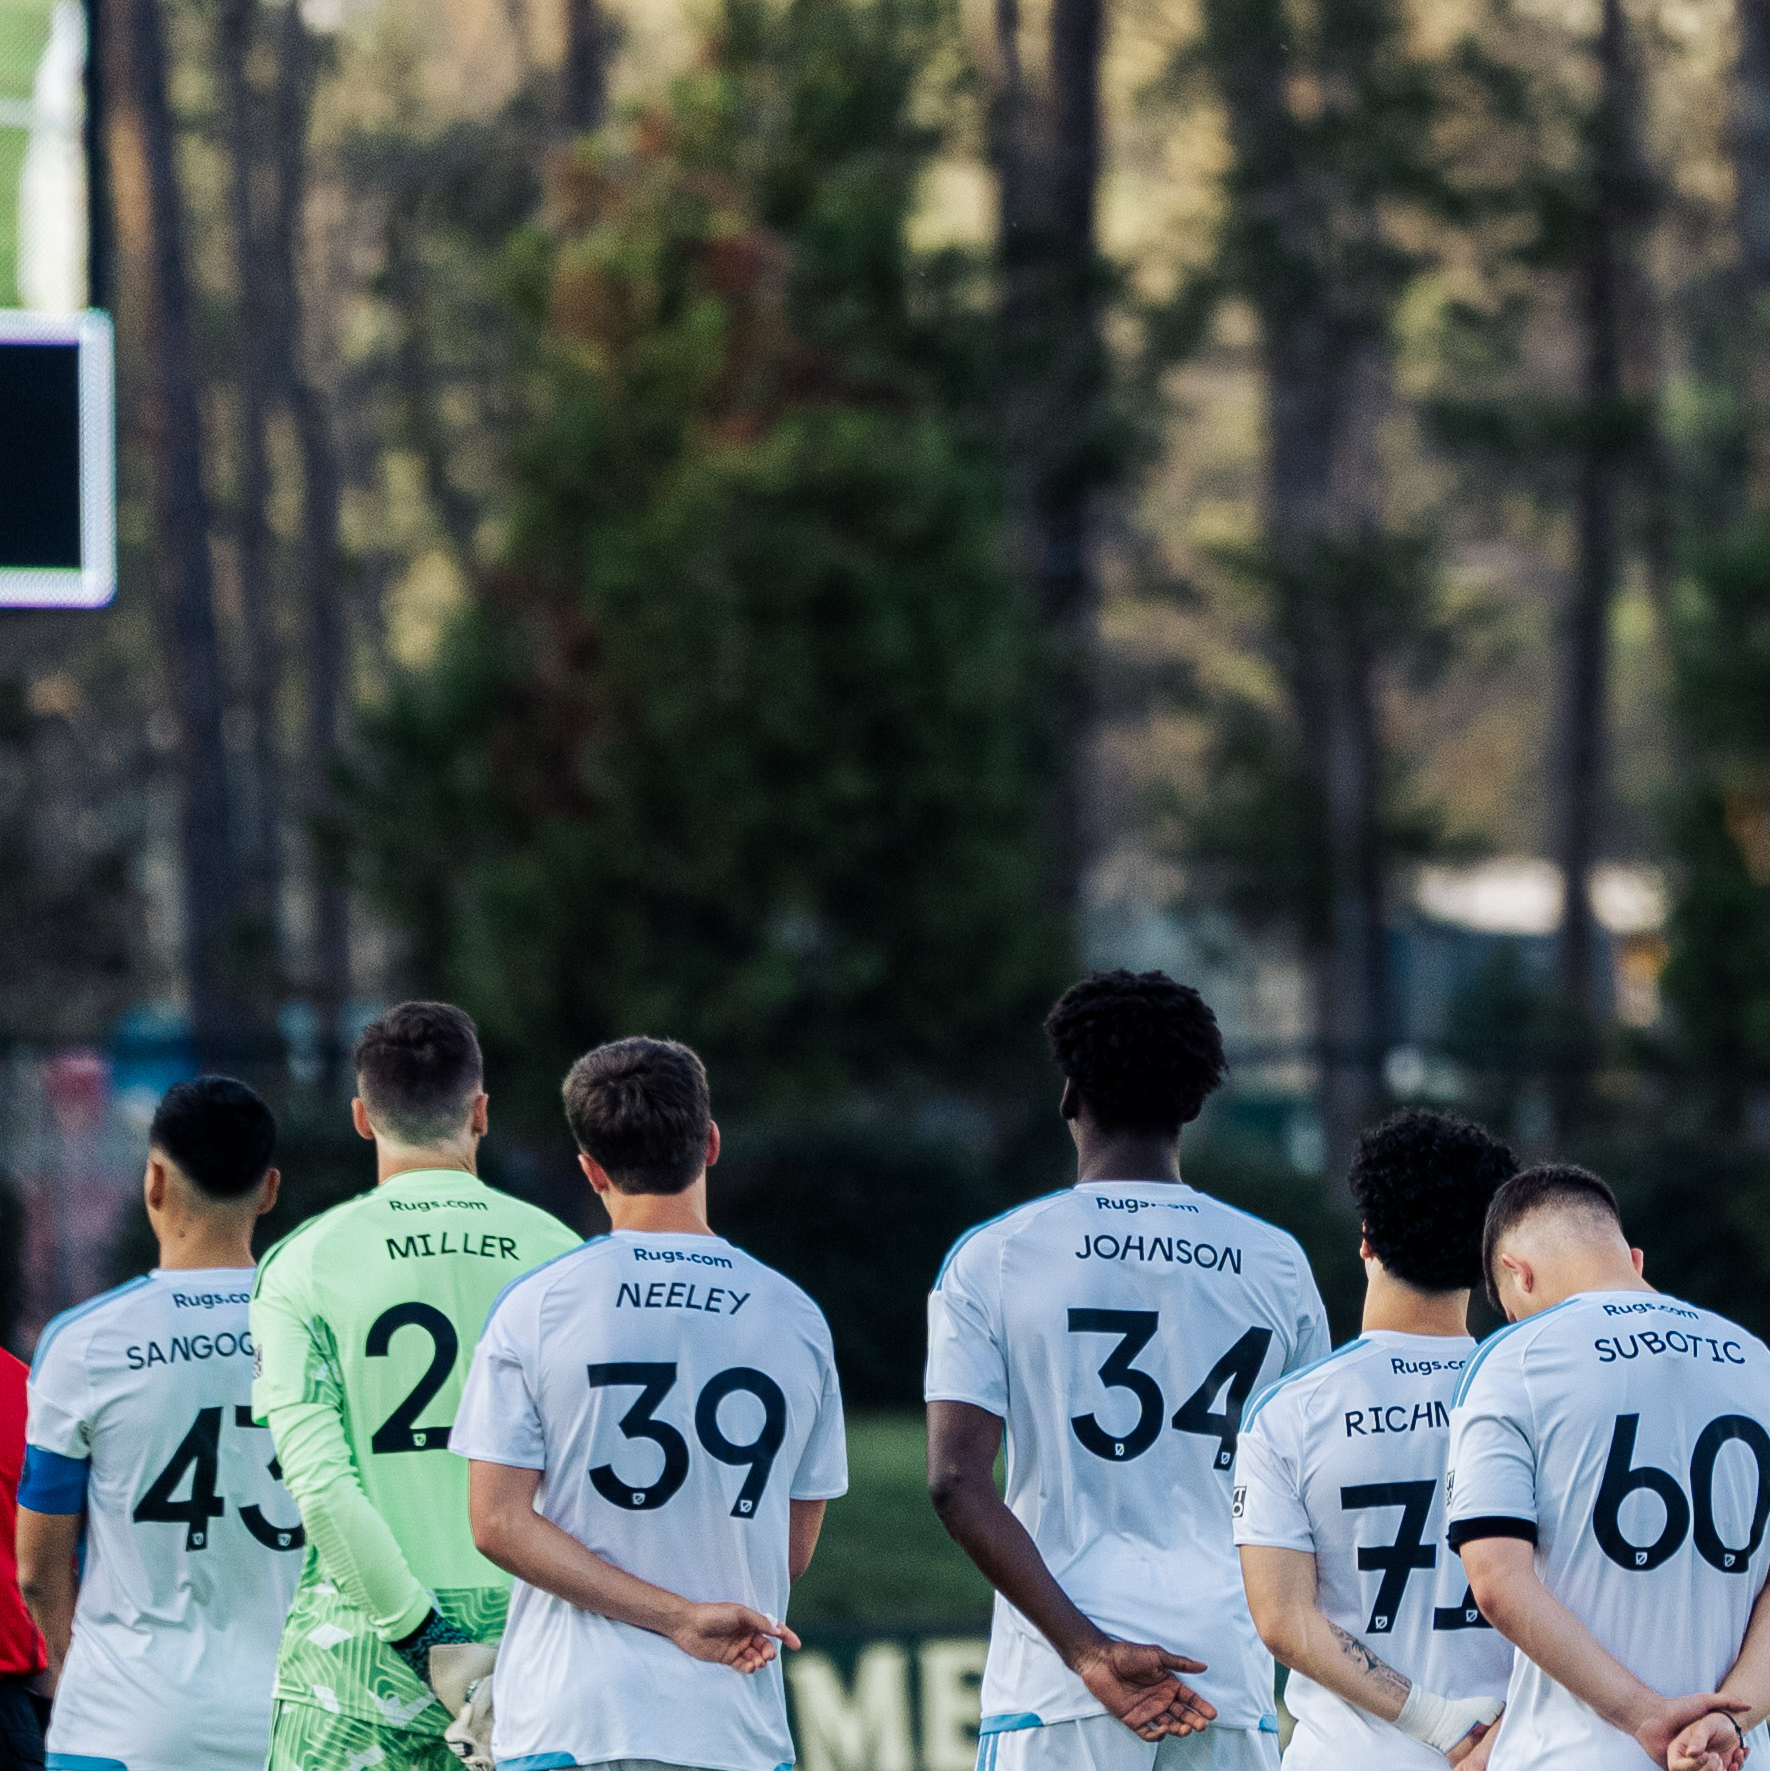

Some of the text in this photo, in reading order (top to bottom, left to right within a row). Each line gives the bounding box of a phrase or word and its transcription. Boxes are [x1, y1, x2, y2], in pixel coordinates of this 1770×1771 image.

[389, 1200, 489, 1213] Rugs.com
[386, 1232, 520, 1261] MILLER
[634, 1248, 733, 1269] Rugs.com
[1075, 1235, 1242, 1275] JOHNSON
[616, 1282, 750, 1315] NEELEY
[1602, 1303, 1699, 1320] Rugs.com
[1594, 1331, 1746, 1364] SUBOTIC
[1067, 1308, 1273, 1471] 34
[587, 1362, 786, 1519] 39
